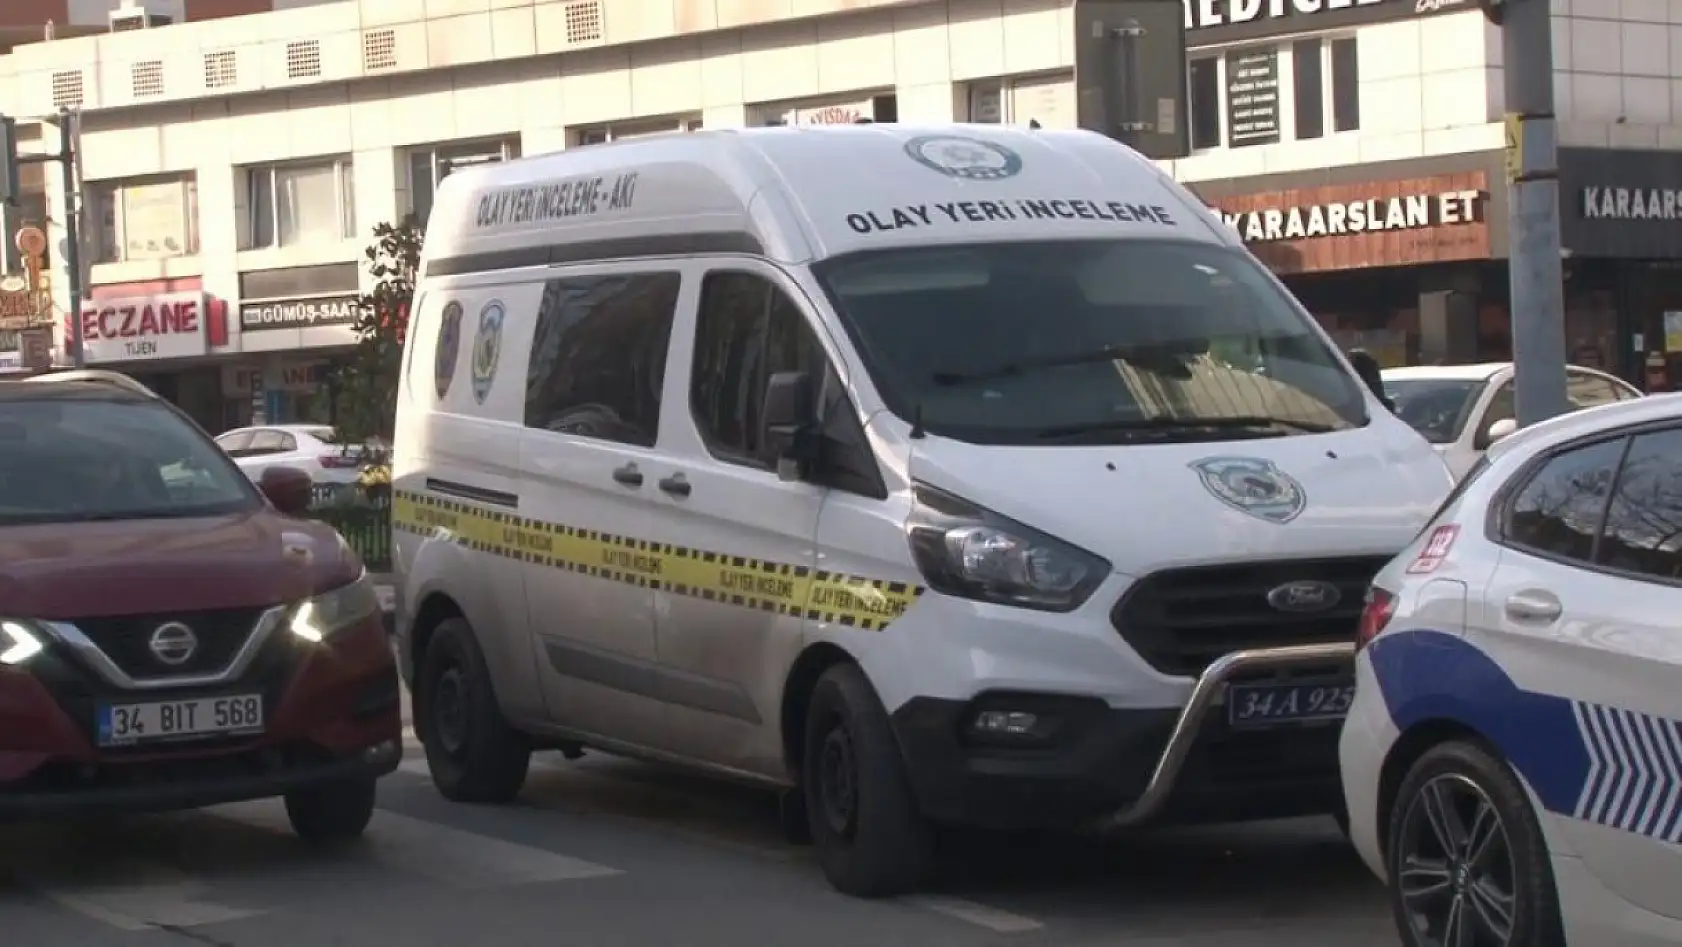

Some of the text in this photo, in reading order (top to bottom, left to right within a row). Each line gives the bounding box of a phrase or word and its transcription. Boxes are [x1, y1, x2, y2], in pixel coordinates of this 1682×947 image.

[846, 203, 933, 235] OLAY
[1225, 189, 1479, 241] KARAARSLAN ET
[82, 301, 198, 339] ECZANE
[114, 697, 258, 735] 34 BIT 568
[1238, 690, 1275, 719] 34
[1275, 687, 1299, 715] A
